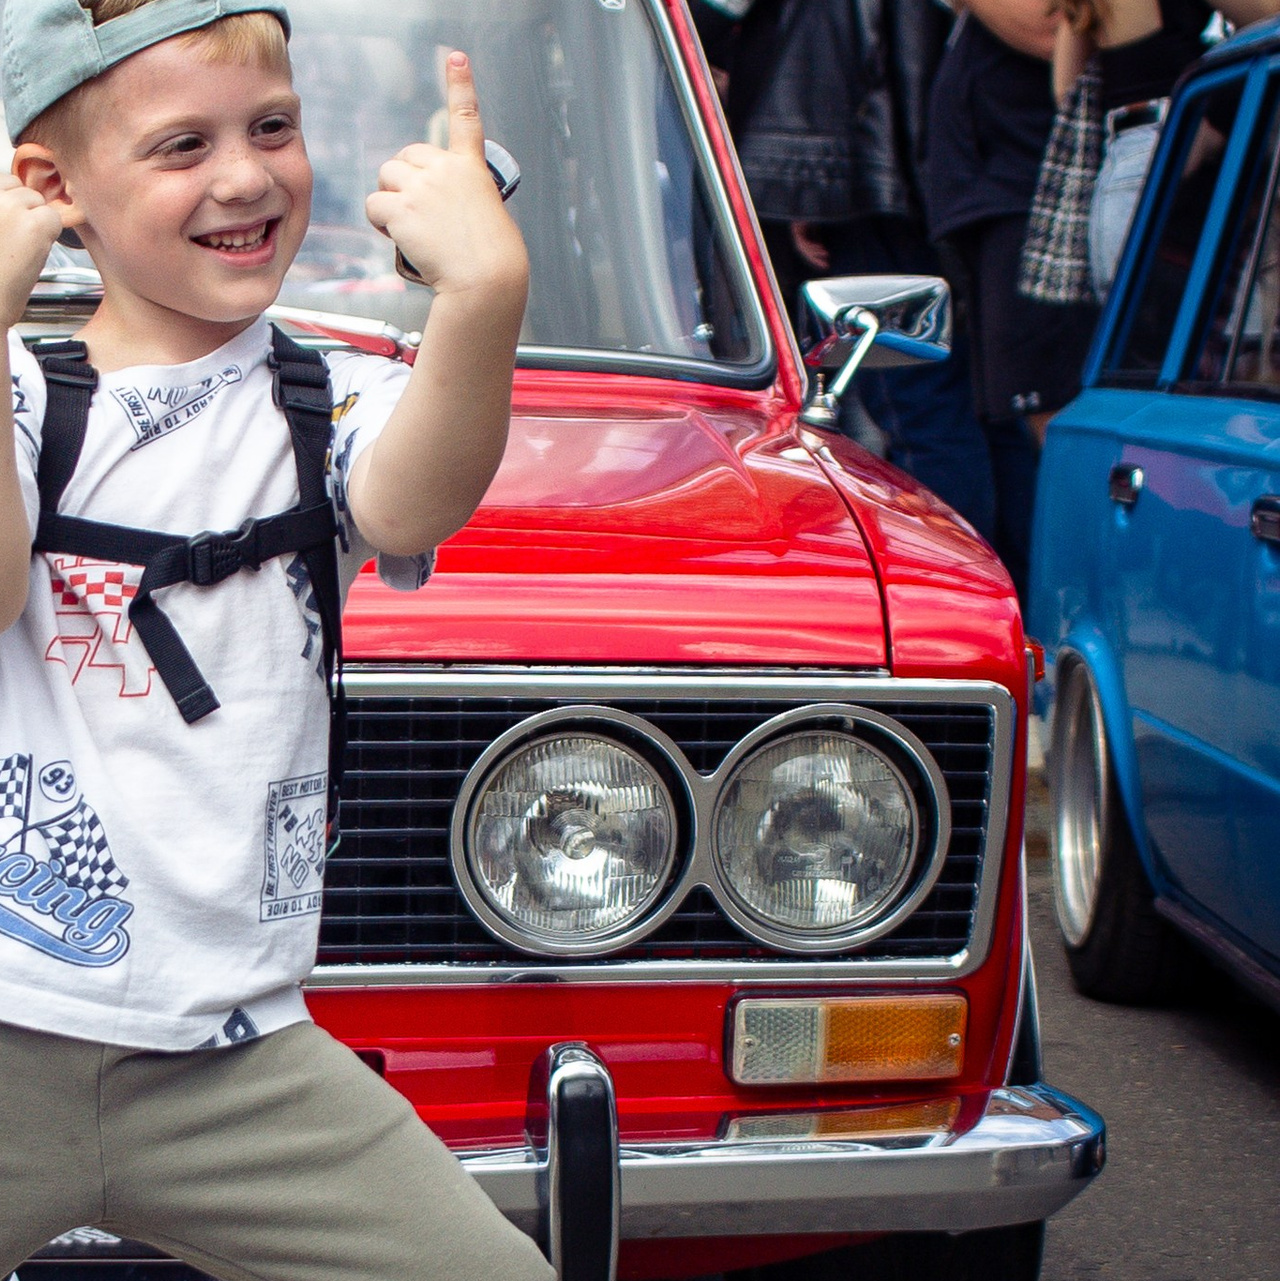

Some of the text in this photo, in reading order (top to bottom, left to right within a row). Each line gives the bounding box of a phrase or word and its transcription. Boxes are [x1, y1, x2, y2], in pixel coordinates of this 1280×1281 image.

[120, 390, 146, 417] FIRST
[186, 391, 217, 419] EADY
[137, 422, 161, 442] RID
[165, 414, 182, 430] TO
[41, 767, 75, 795] 93
[281, 782, 298, 797] BEST
[265, 789, 278, 897] BE FIRST FOREVER
[280, 843, 310, 889] NO
[267, 901, 289, 917] RIDE
[291, 899, 303, 912] TO
